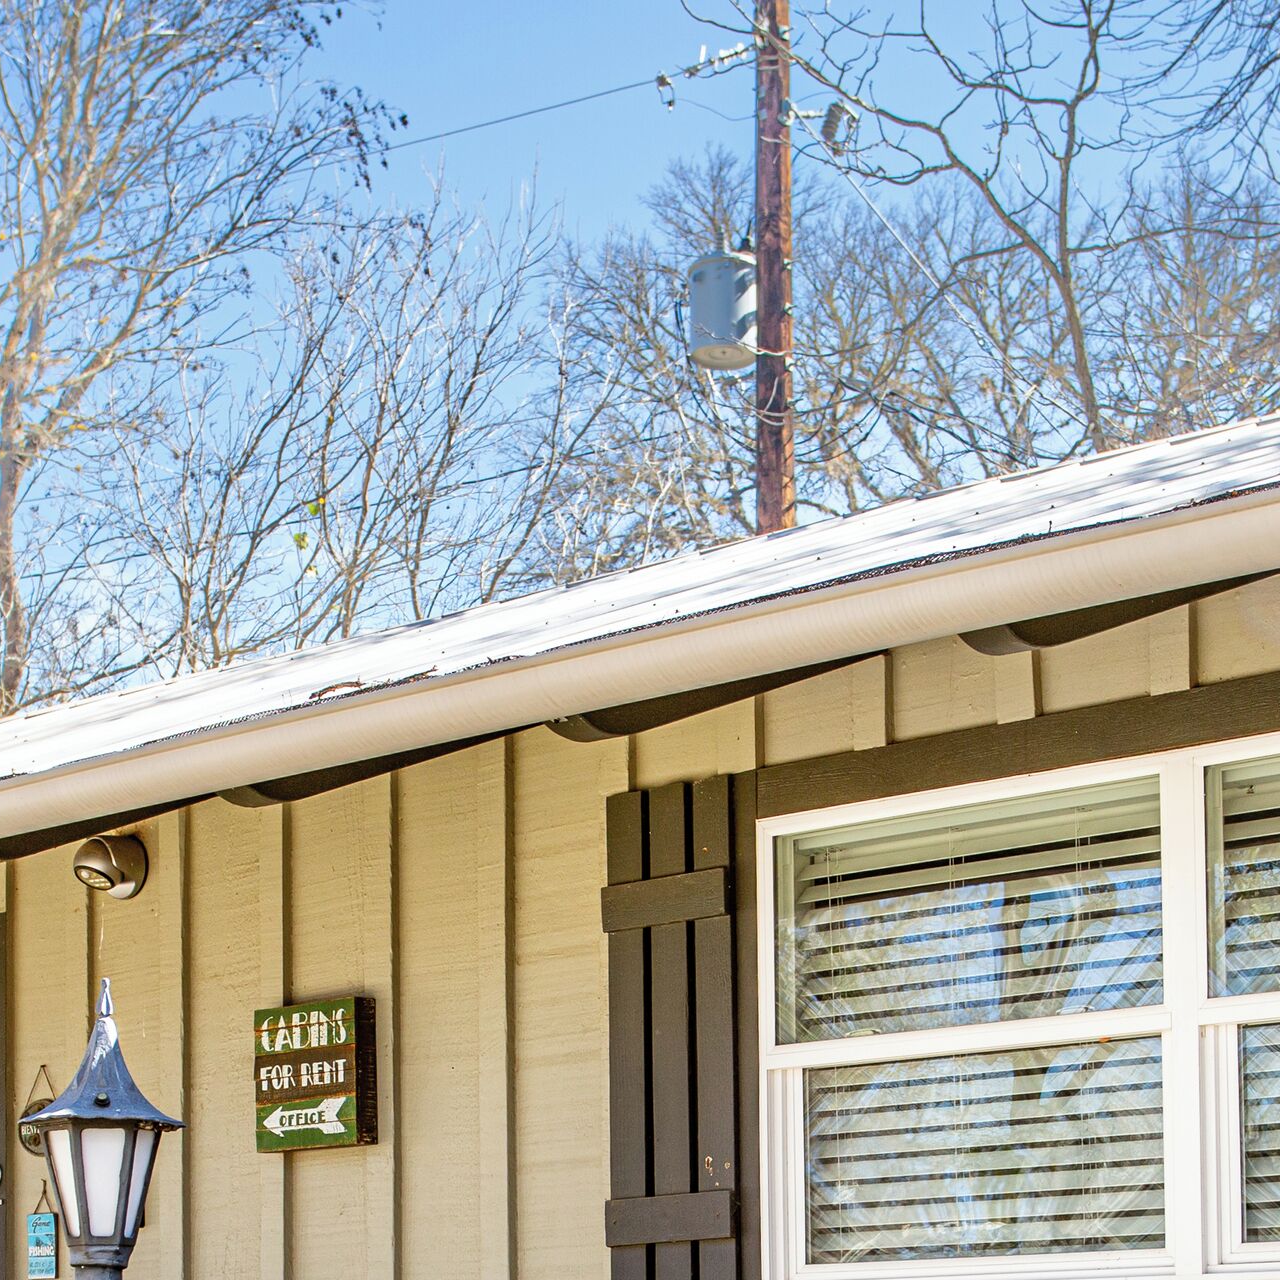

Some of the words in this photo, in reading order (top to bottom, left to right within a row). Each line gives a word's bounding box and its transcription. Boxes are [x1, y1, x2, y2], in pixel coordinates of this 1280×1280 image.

[261, 1008, 347, 1052] CABINS
[260, 1065, 295, 1091] FOR
[300, 1059, 347, 1088] RENT
[281, 1111, 326, 1126] OFFICE
[29, 1245, 54, 1257] FISHING
